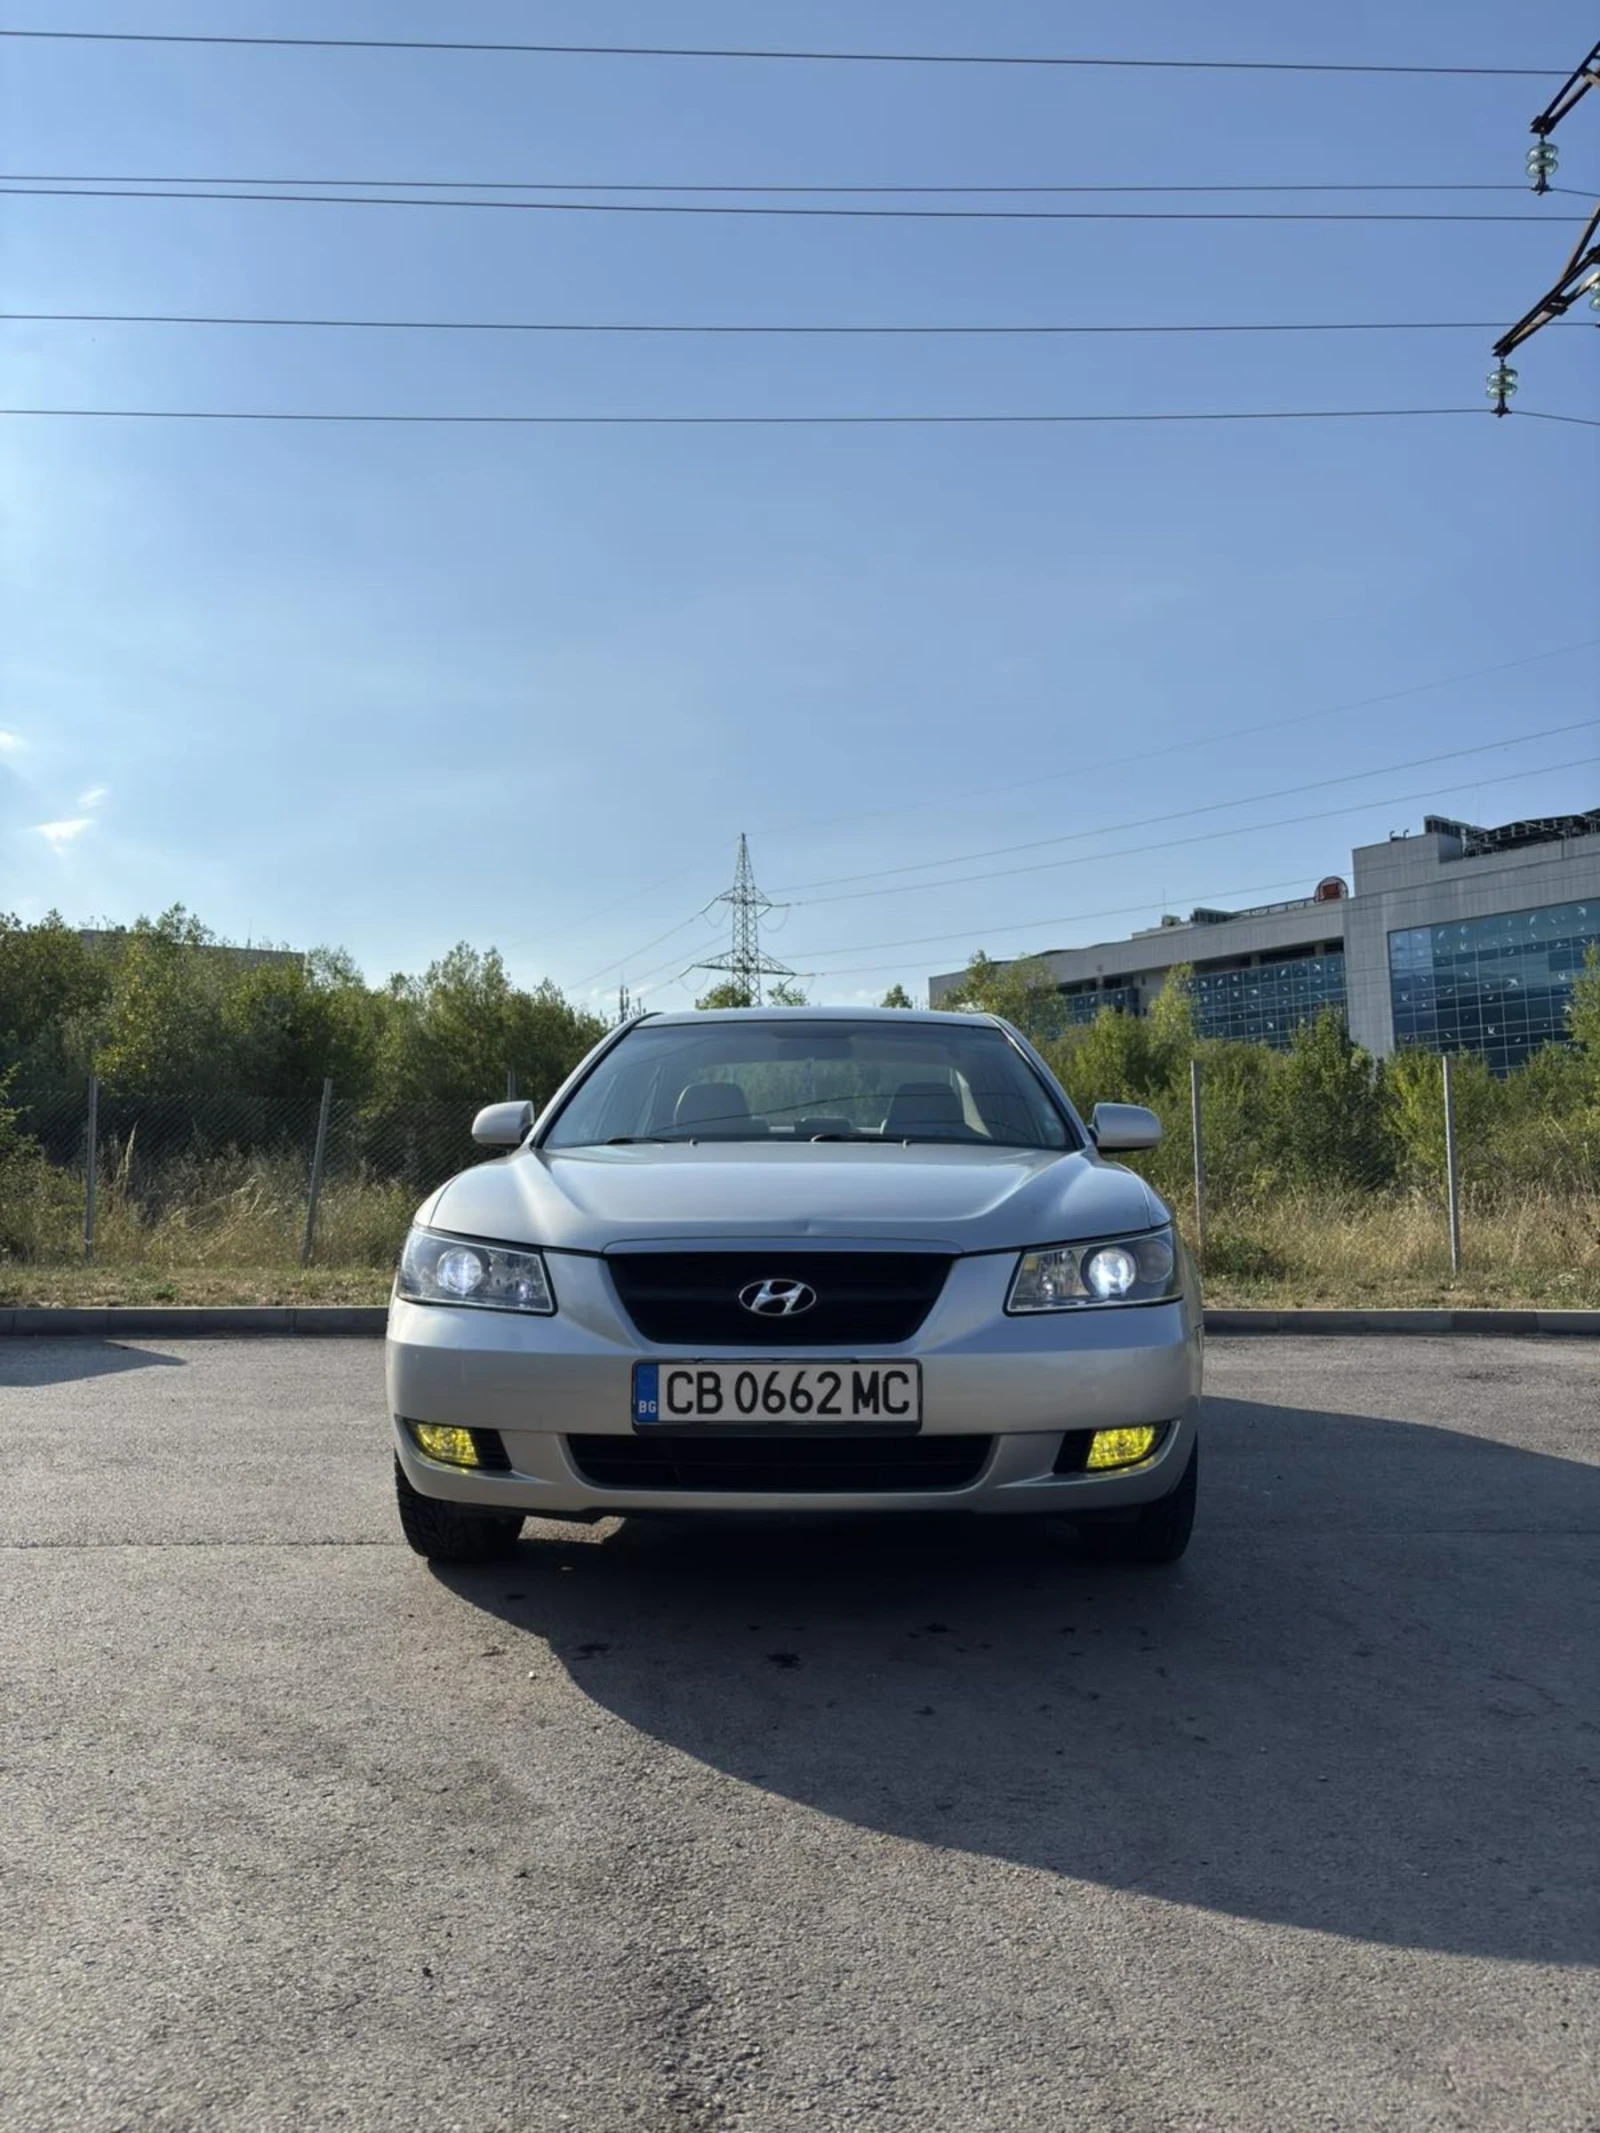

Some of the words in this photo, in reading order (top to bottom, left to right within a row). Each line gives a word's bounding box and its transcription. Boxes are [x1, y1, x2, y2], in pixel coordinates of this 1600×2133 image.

[639, 1400, 657, 1413] BG
[666, 1371, 724, 1414] CB
[734, 1371, 842, 1414] 0662
[852, 1371, 910, 1414] MC
